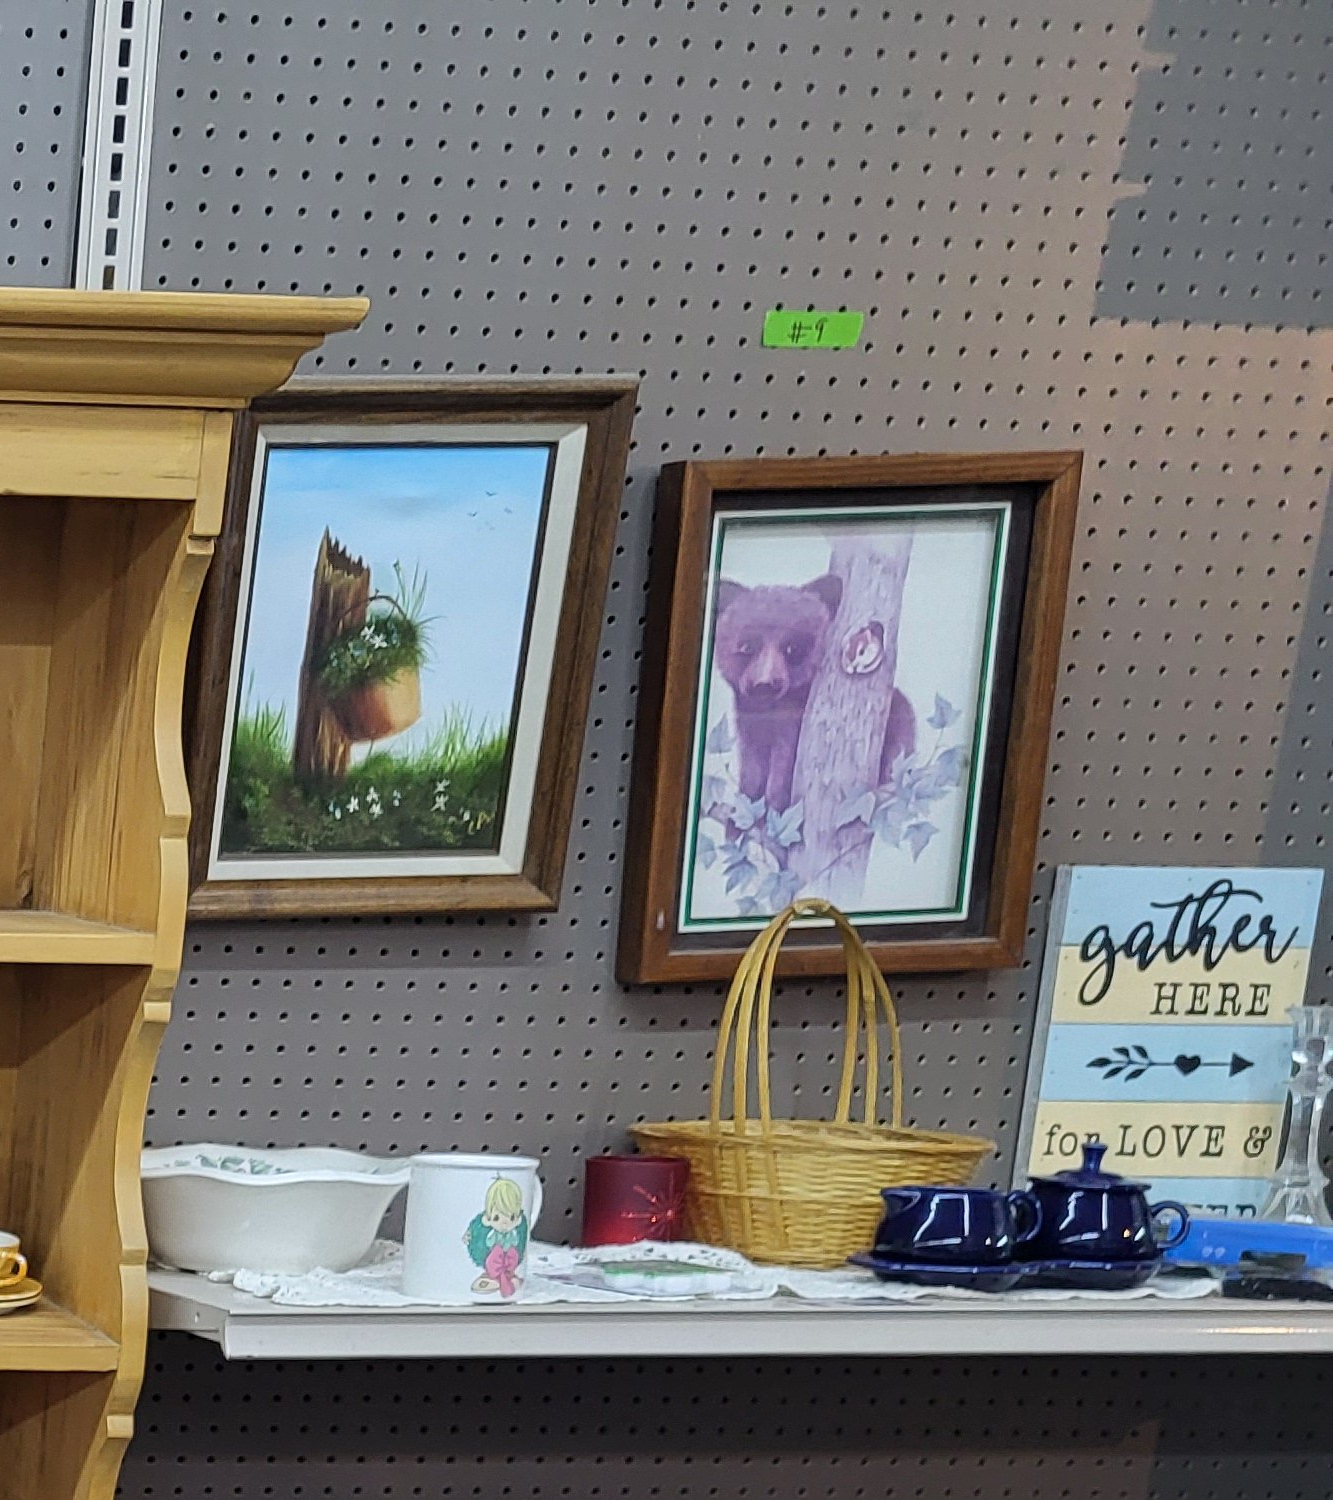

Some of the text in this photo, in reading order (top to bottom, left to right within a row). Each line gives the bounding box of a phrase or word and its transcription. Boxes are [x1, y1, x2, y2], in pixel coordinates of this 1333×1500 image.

[1077, 878, 1300, 1006] gather
[1149, 982, 1272, 1016] HERE
[1115, 1124, 1226, 1158] LOVE
[1243, 1125, 1273, 1158] &
